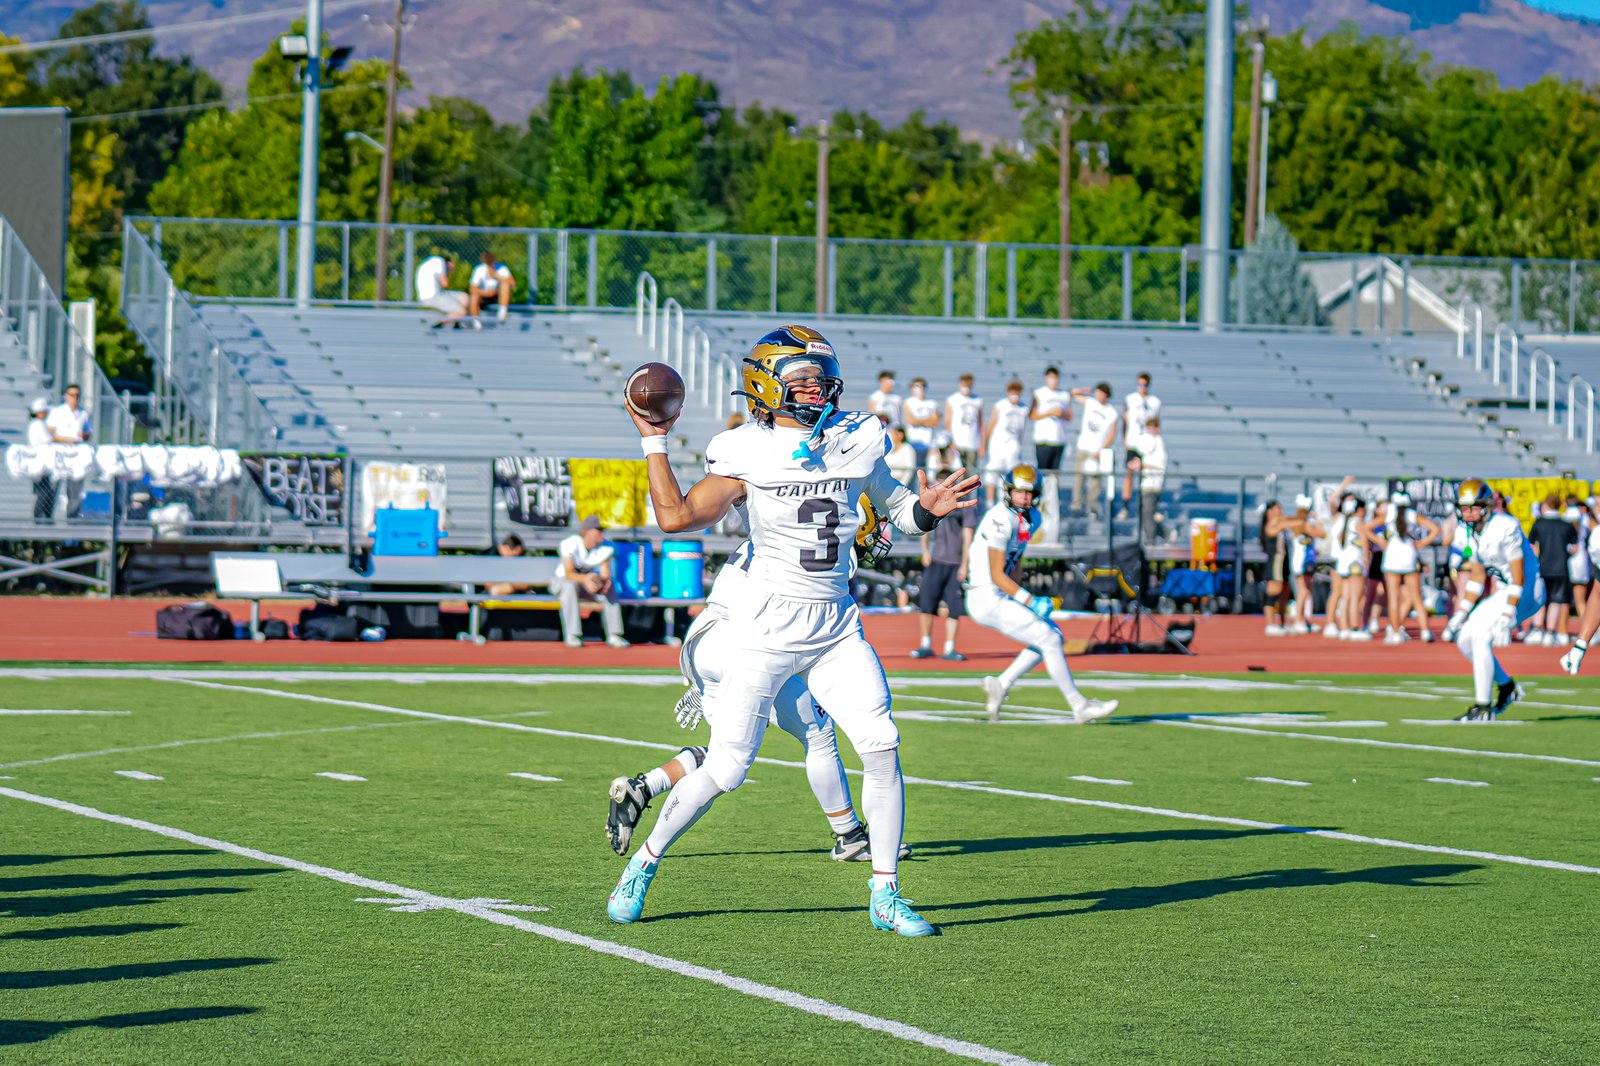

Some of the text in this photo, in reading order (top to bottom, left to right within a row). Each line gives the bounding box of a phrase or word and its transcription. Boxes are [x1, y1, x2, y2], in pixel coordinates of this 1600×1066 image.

[263, 457, 341, 495] BEAT
[776, 479, 850, 496] CAPITAL
[798, 497, 840, 572] 3
